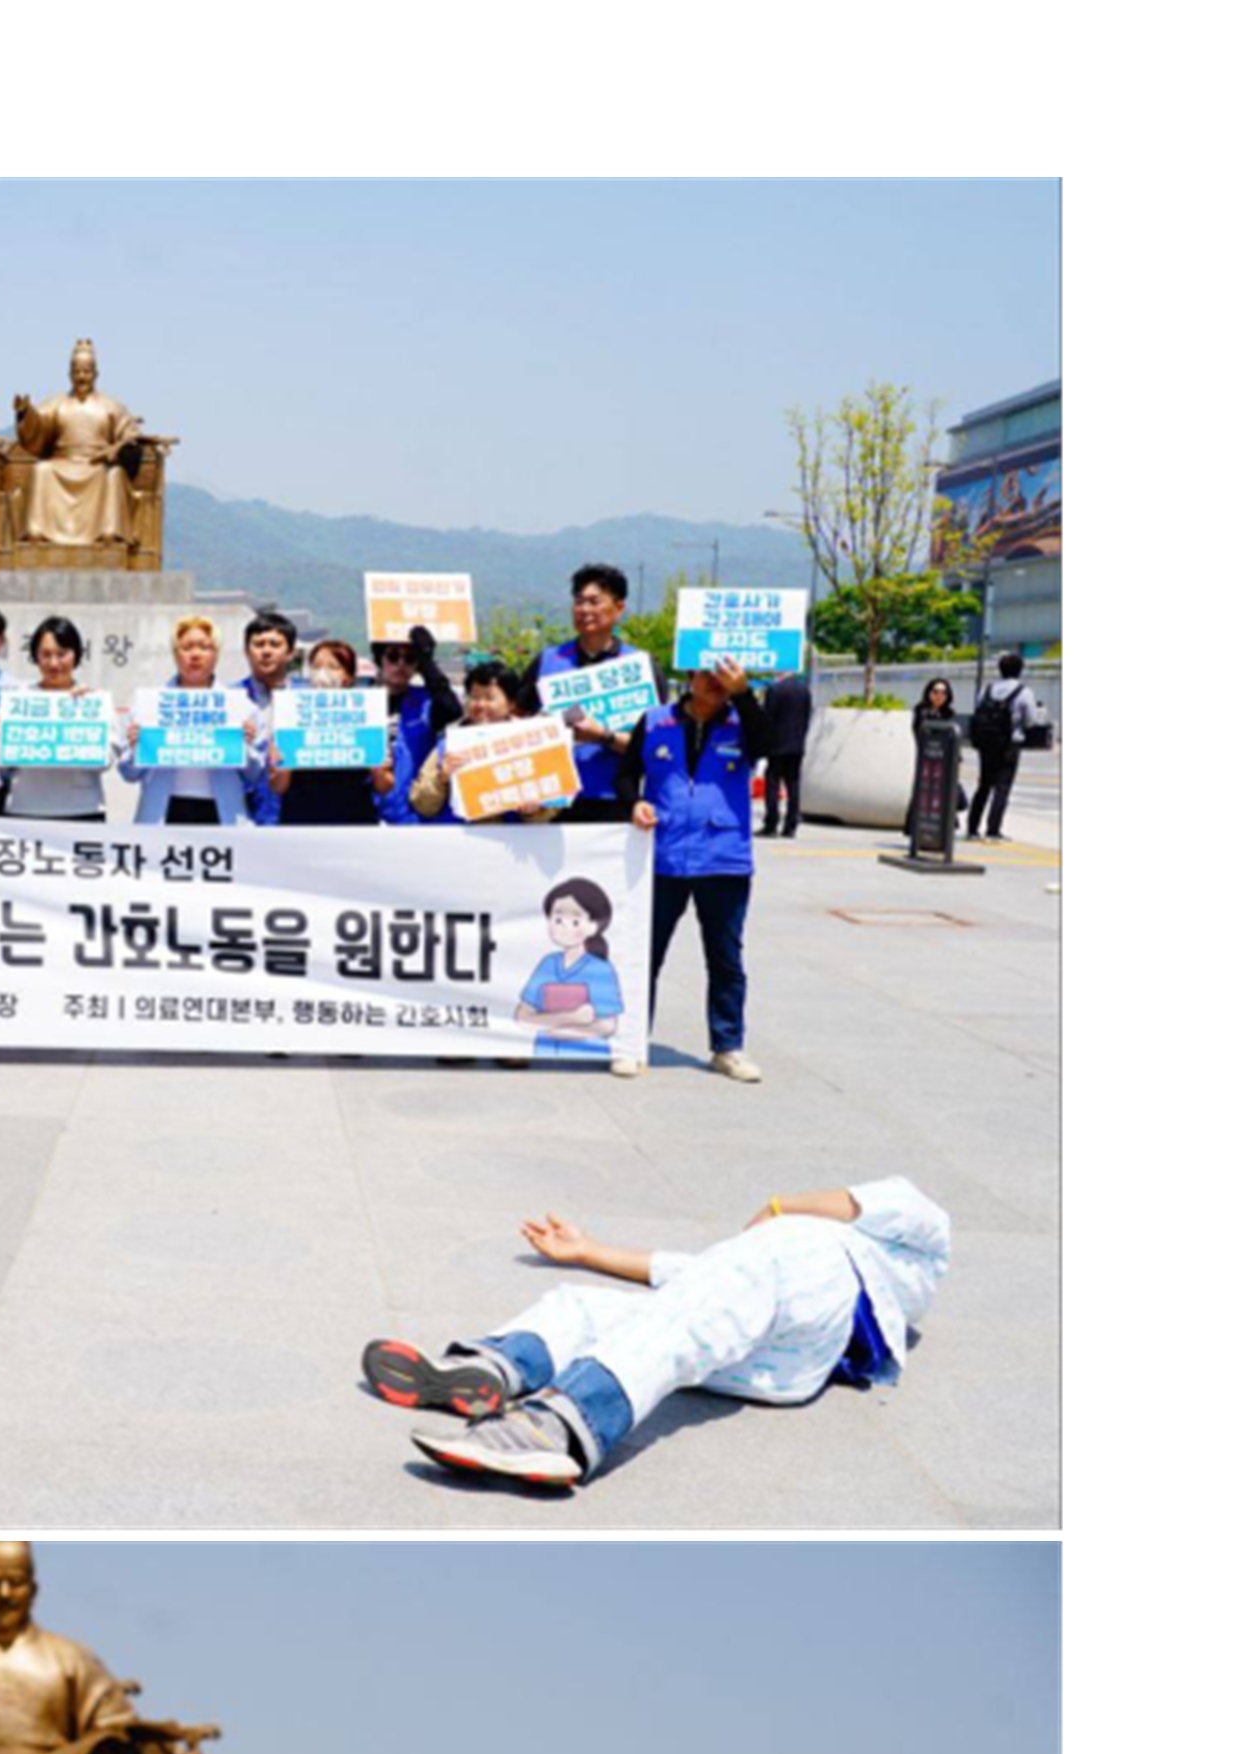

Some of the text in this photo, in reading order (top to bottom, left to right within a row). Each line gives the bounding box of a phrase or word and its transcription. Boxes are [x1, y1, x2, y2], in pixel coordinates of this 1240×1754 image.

[160, 845, 234, 884] 선언
[69, 899, 311, 979] 간호노동을
[334, 908, 497, 984] 원한다
[63, 994, 109, 1020] 주최
[135, 996, 285, 1024] 의료연대본부,
[292, 1000, 386, 1027] 행동하는
